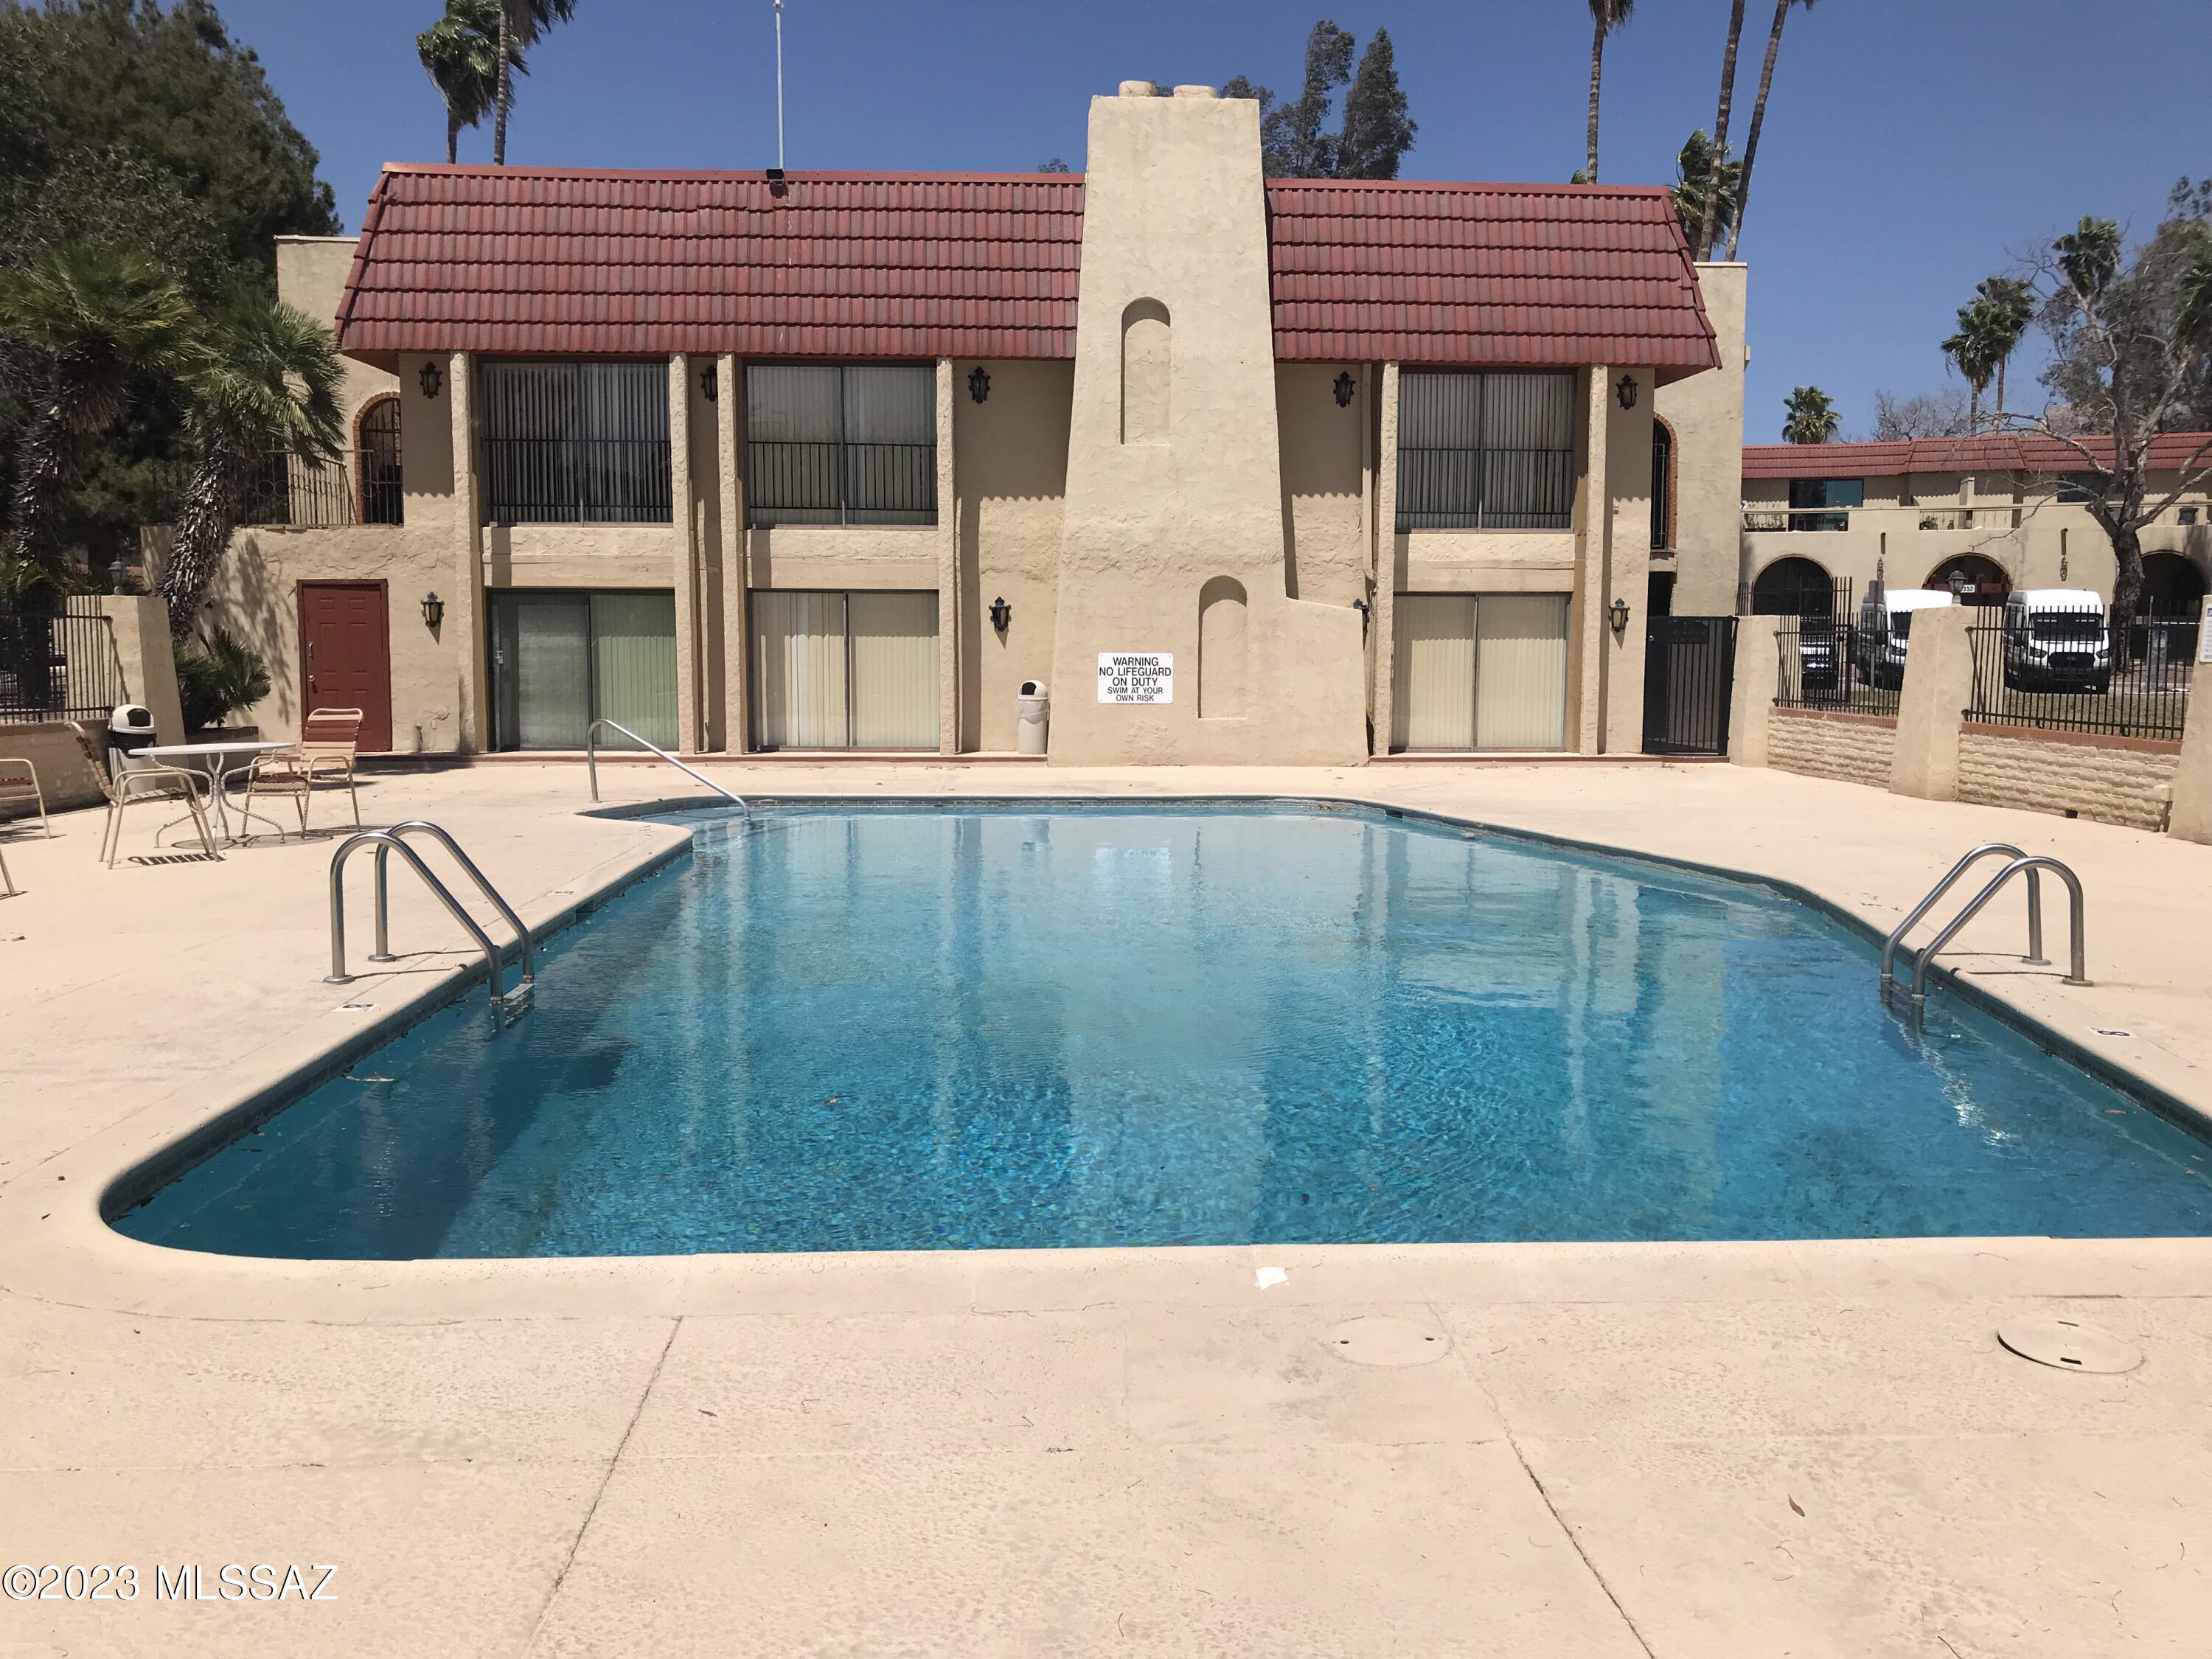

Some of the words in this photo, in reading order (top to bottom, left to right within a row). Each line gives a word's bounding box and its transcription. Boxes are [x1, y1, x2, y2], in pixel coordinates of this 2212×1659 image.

[1113, 657, 1158, 666] WARNING
[1099, 667, 1113, 676] NO
[1118, 667, 1172, 676] LIFEGUARD
[1113, 677, 1127, 686] ON
[1131, 677, 1158, 686] DUTY
